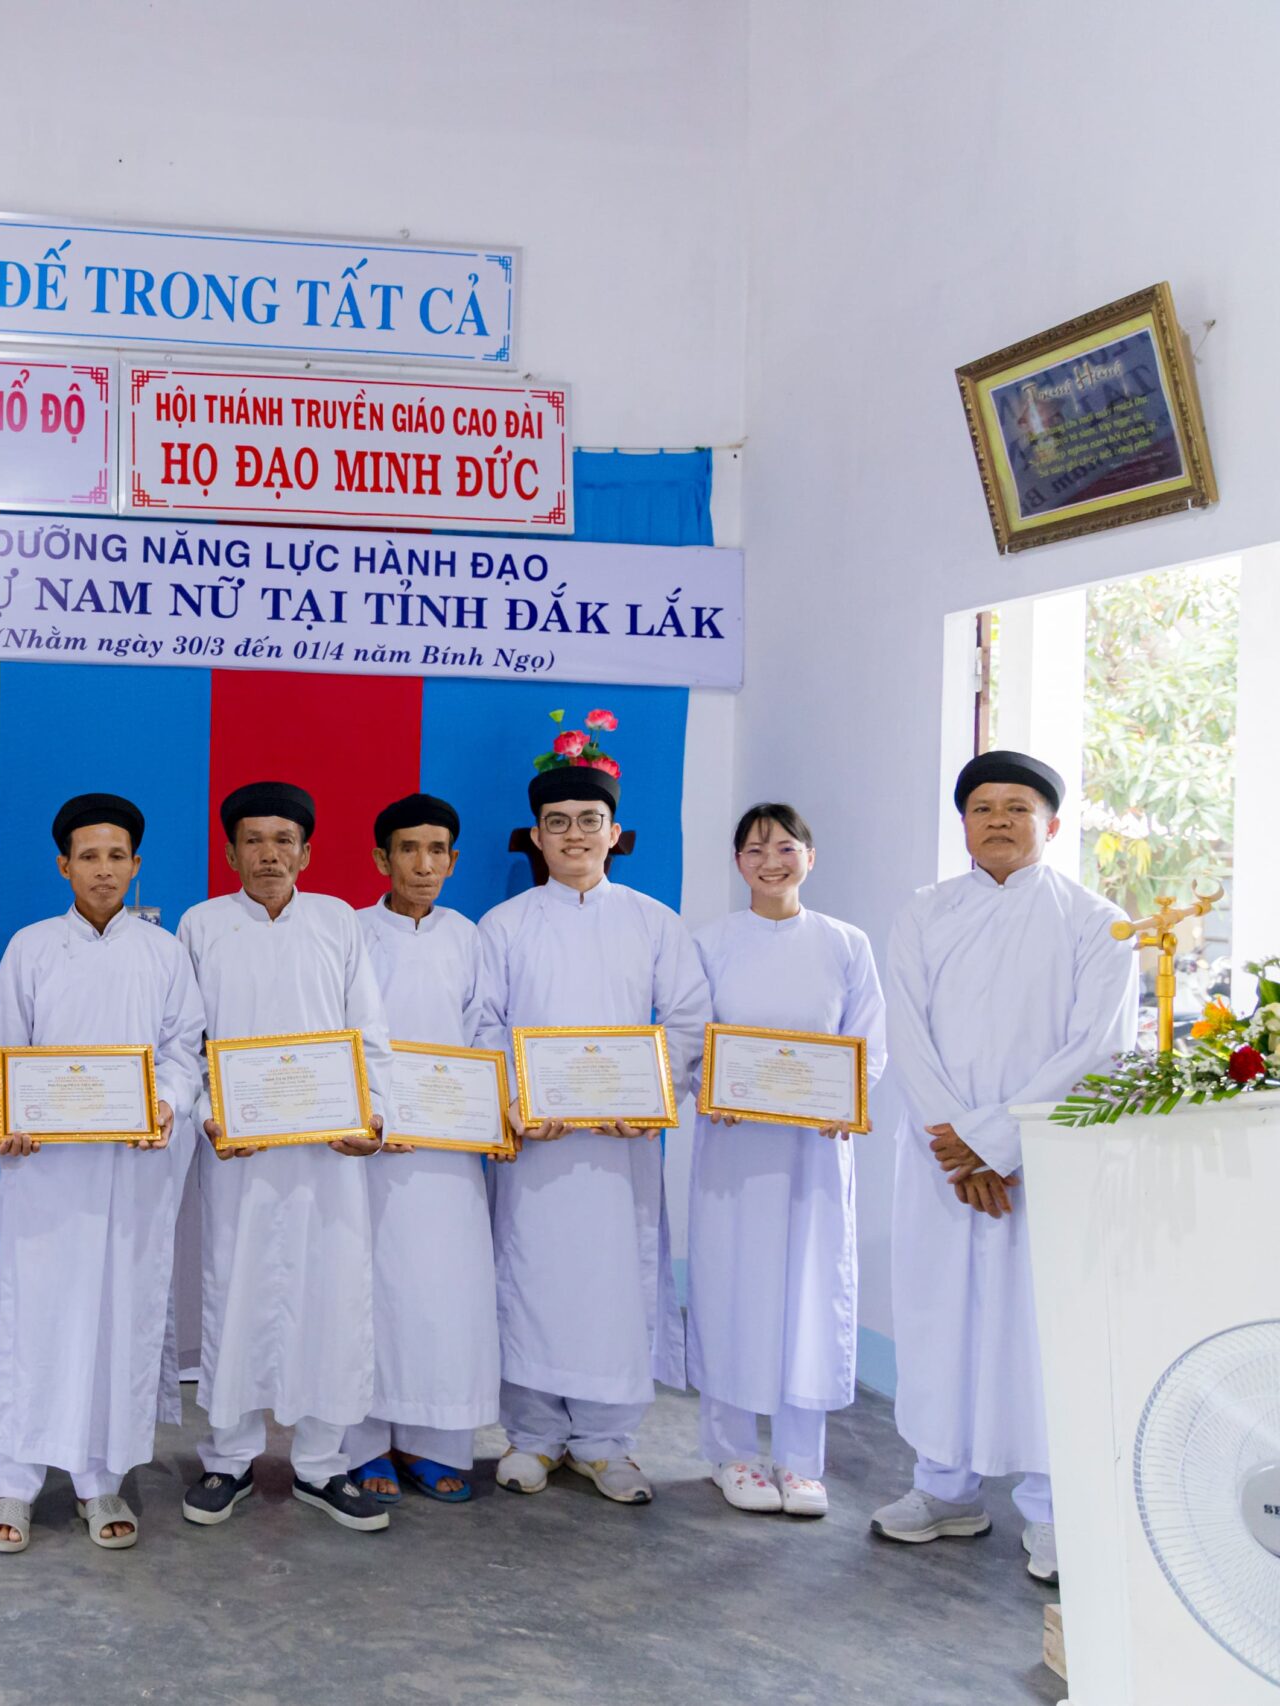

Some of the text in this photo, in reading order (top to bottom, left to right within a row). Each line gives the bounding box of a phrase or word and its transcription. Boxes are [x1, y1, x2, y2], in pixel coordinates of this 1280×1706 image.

[85, 266, 281, 326] TRONG
[296, 257, 404, 331] TẤT
[419, 271, 491, 337] CẢ
[41, 383, 86, 444] ĐỘ
[156, 385, 544, 440] HỘI THÁNH TRUYỀN GIÁO CAO ĐÀI
[161, 442, 540, 502] HỌ ĐẠO MINH ĐỨC
[142, 530, 251, 569] NĂNG
[266, 540, 340, 576] LỰC
[354, 540, 457, 578] HÀNH
[470, 552, 549, 586] ĐẠO
[35, 577, 153, 616] NAM
[168, 575, 246, 619] NỮ
[261, 586, 349, 631] TẠI
[364, 579, 489, 630] TỈNH
[504, 582, 610, 635] ĐẮK
[625, 587, 725, 640] LẮK
[98, 634, 164, 658] ngày
[172, 634, 225, 657] 30/3
[234, 635, 284, 659] đến
[293, 640, 345, 662] 01/4
[353, 644, 412, 665] năm
[421, 645, 485, 667] Bính
[492, 648, 556, 673] Ngọ)
